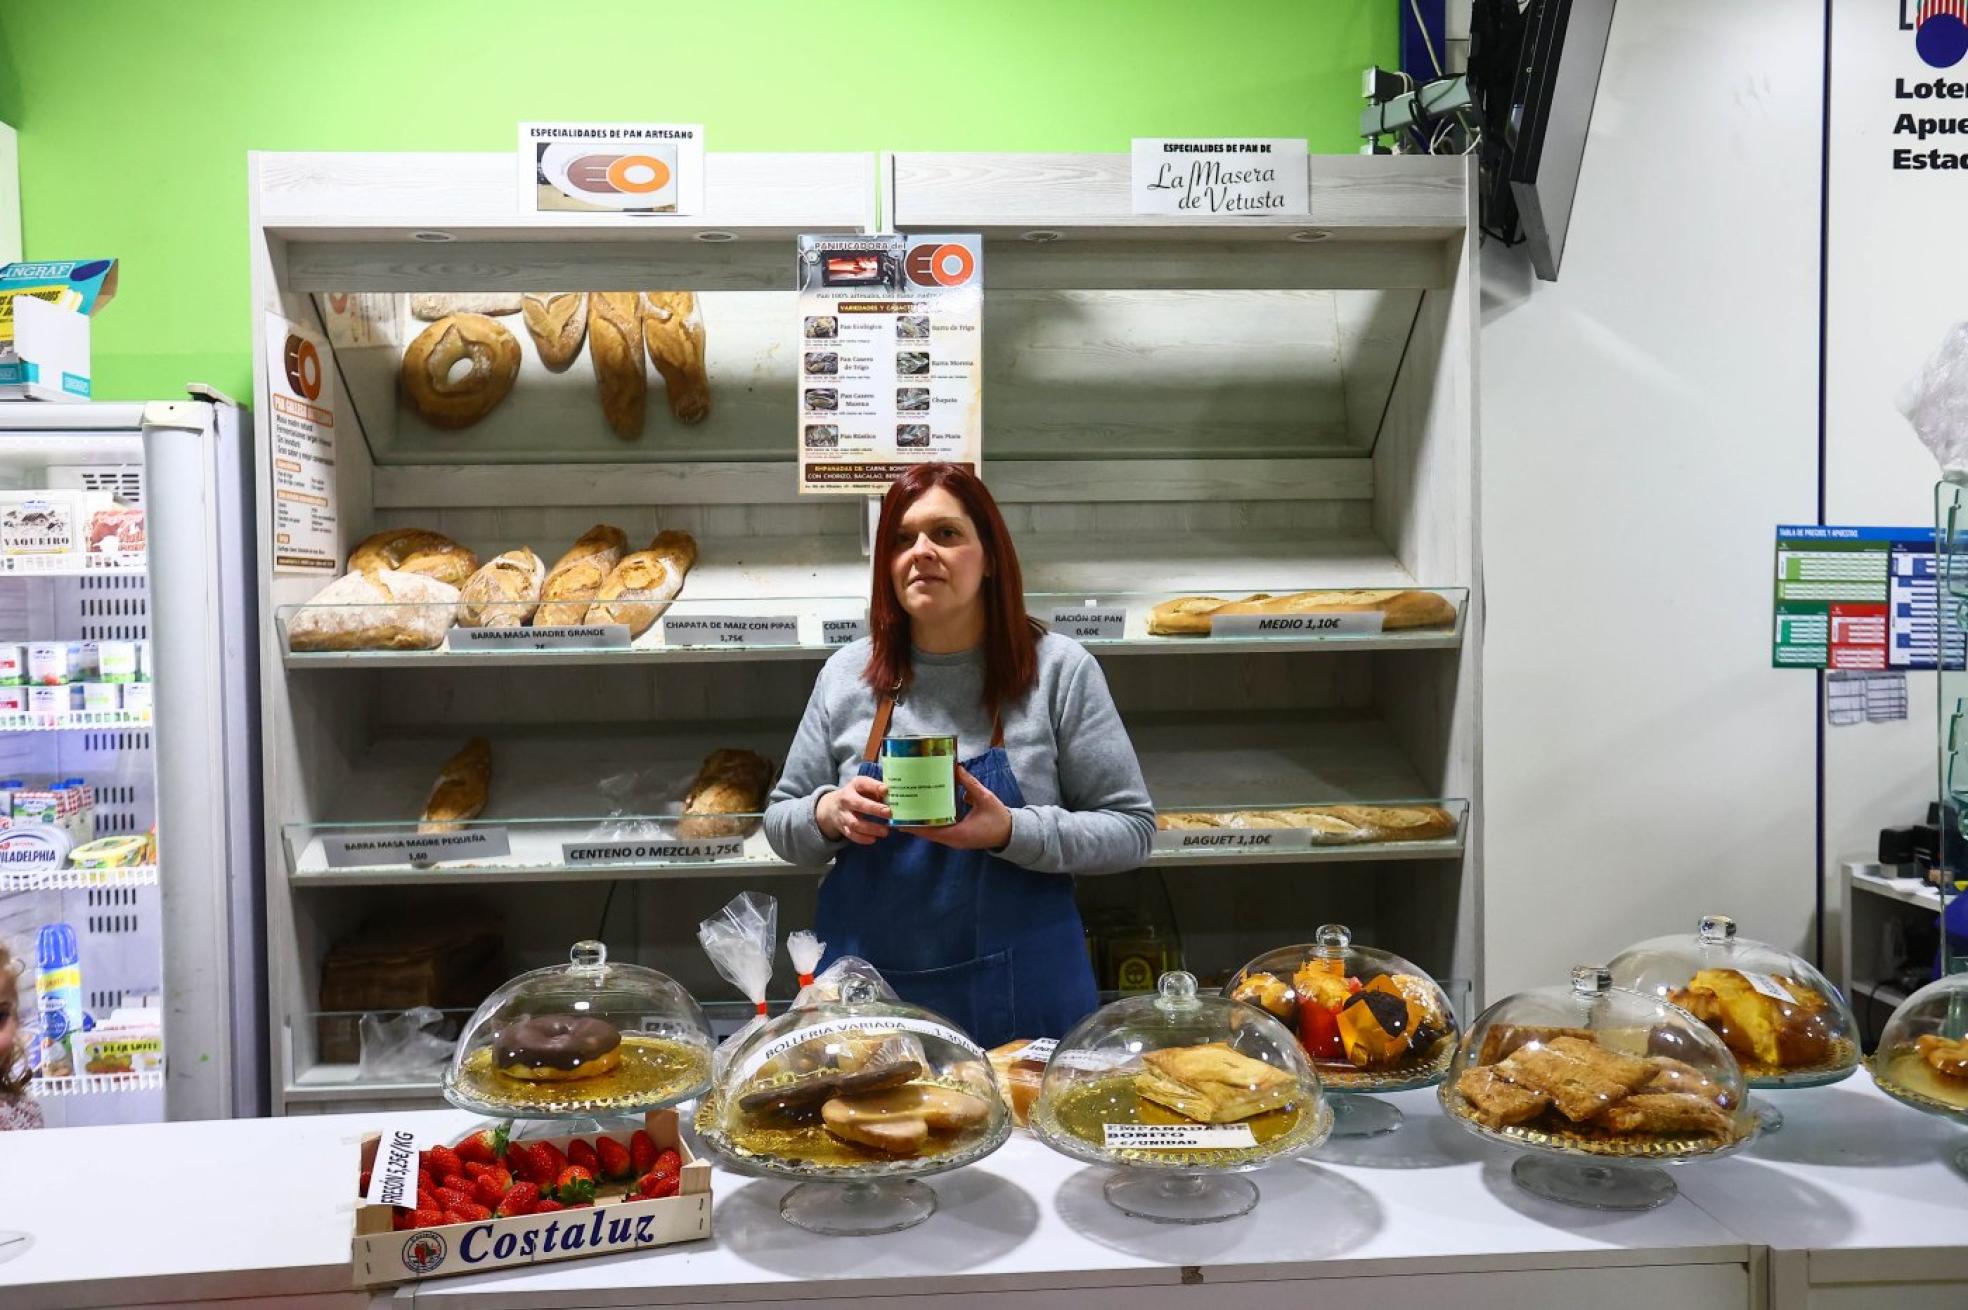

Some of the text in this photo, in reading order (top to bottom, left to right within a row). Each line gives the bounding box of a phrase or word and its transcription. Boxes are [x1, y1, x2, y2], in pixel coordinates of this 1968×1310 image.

[1895, 77, 1968, 99] Lote
[530, 128, 693, 139] ESPECIALIDADES DE PAN ARTESANO
[1163, 143, 1271, 153] ESPECIALIDES DE PAN DE
[1147, 160, 1275, 190] La Masera
[1204, 176, 1285, 212] Vetusta
[891, 241, 907, 251] del
[1055, 614, 1088, 623] RACIÓN
[1259, 617, 1341, 630] MEDIO 1,10€
[666, 621, 708, 630] CHAPATA
[710, 621, 722, 629] DE
[749, 621, 769, 630] CON
[770, 622, 796, 630] PIPAS
[823, 621, 857, 630] COLETA
[471, 628, 606, 640] BARRA MASA MADRE GRANDE
[378, 840, 405, 849] MASA
[406, 838, 440, 848] MADRE
[441, 833, 486, 845] PEQUEÑA
[1183, 835, 1273, 846] BAGUET 1,10€
[570, 843, 740, 860] CENTENO O MEZCLA 1,75€
[459, 1209, 656, 1264] Costaluz
